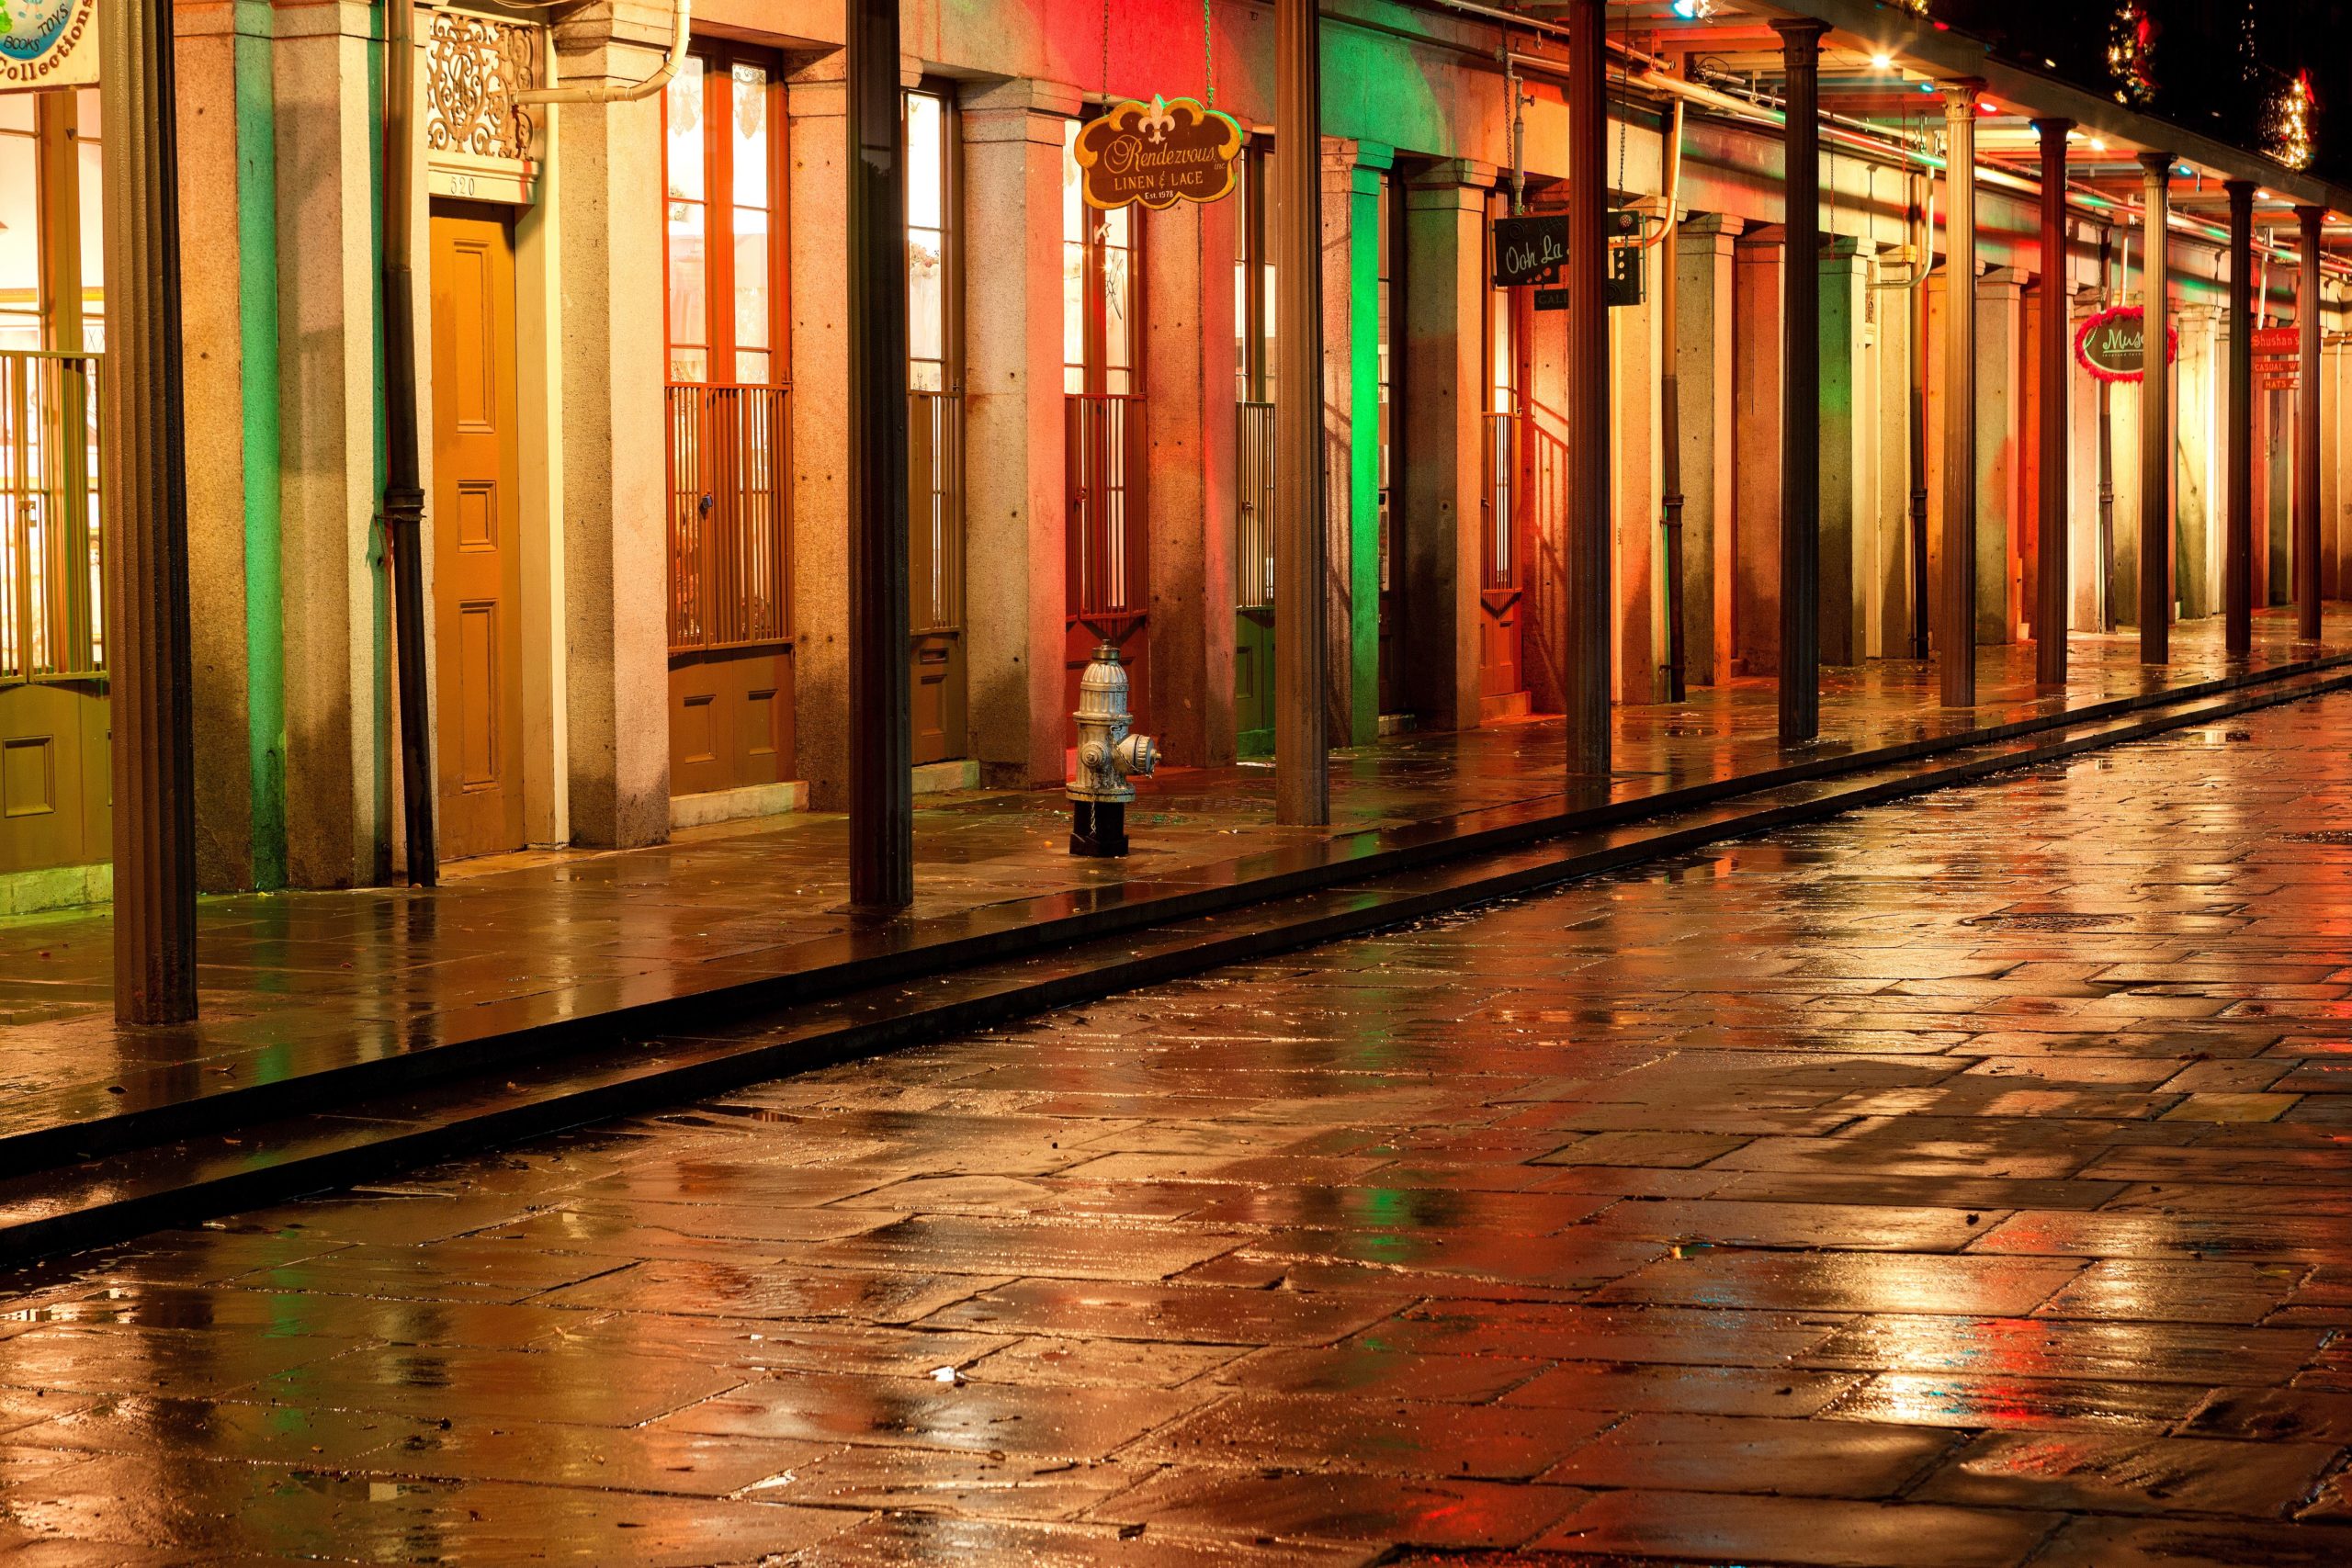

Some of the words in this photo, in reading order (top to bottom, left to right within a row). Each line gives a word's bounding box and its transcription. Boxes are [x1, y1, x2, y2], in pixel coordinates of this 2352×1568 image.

[3, 35, 40, 52] BOOKS
[38, 3, 69, 37] TOYS
[450, 175, 475, 196] 520
[1114, 175, 1155, 191] LINEN
[1159, 170, 1166, 189] &
[1171, 171, 1204, 186] LACE
[1145, 191, 1158, 199] Est.
[1159, 190, 1174, 198] 1978
[1506, 242, 1538, 275] Ooh
[1541, 234, 1563, 265] La
[2255, 363, 2284, 372] CASUAL
[2265, 379, 2287, 389] HATS
